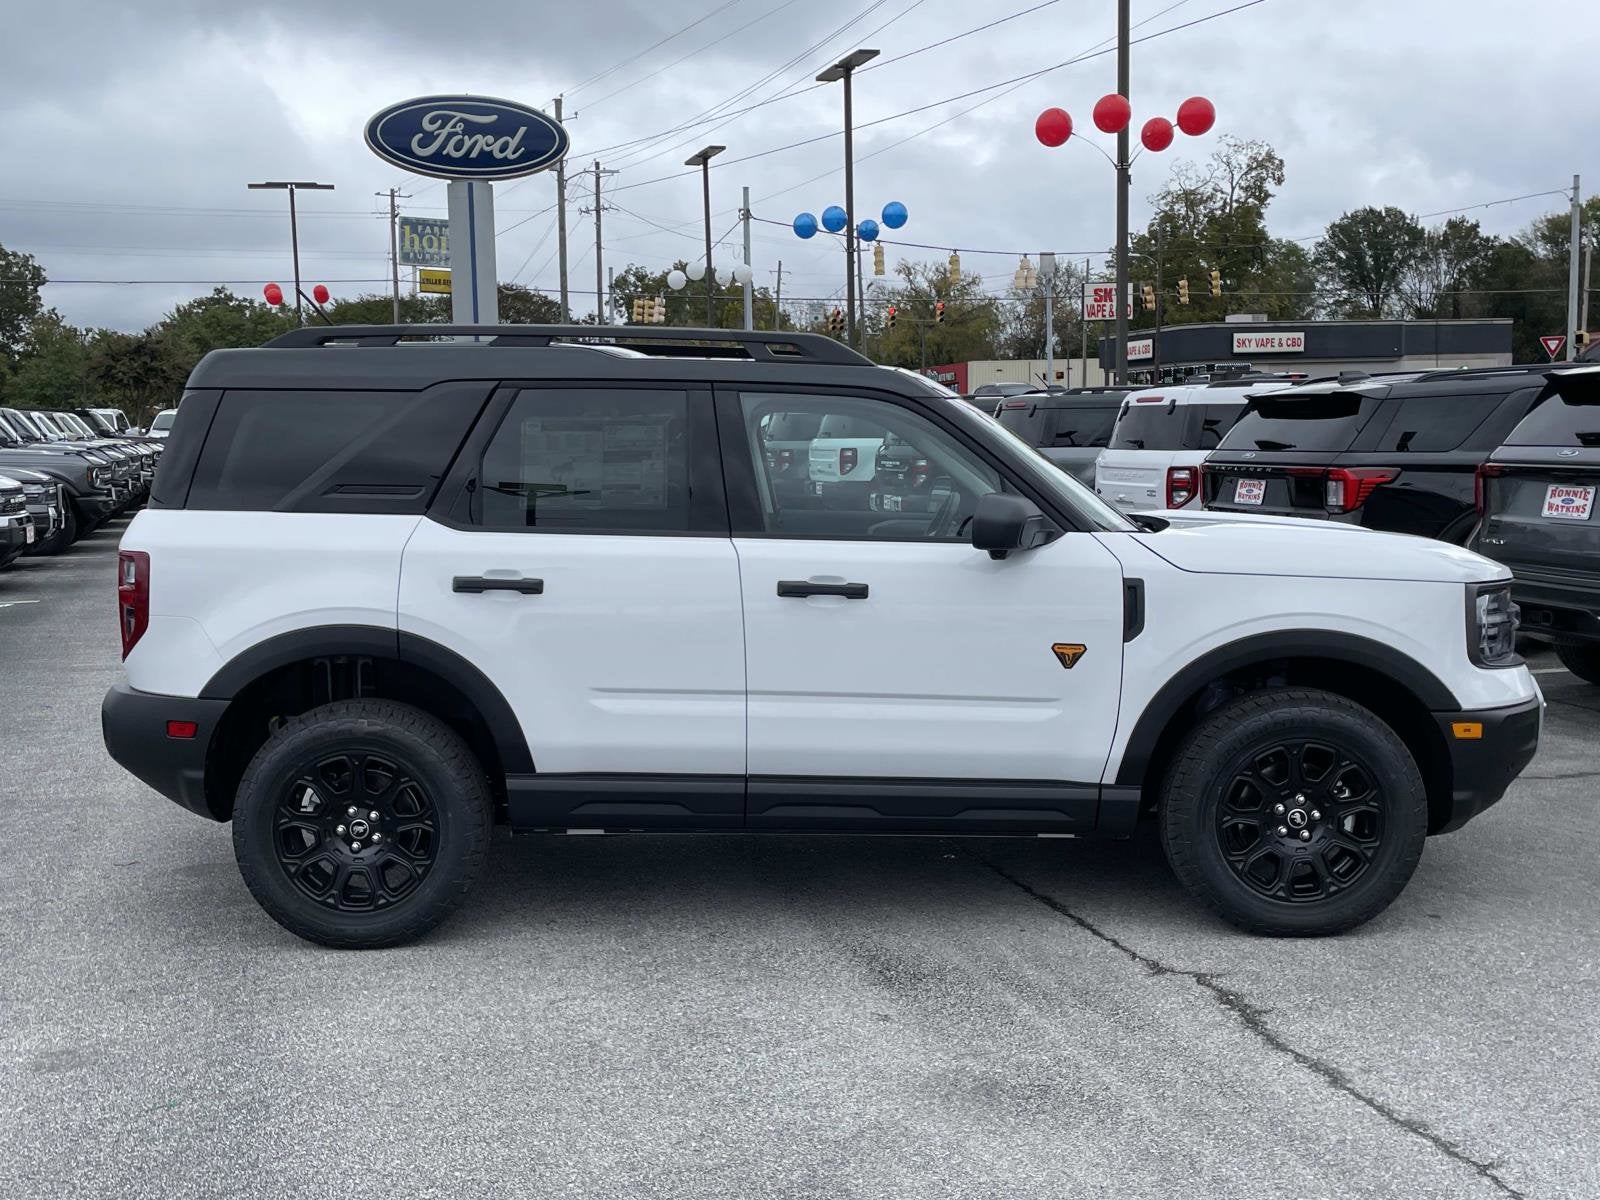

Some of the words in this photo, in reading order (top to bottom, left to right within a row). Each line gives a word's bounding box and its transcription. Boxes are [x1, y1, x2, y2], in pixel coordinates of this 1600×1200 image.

[411, 110, 527, 159] Ford
[1086, 304, 1106, 318] VAPE
[1109, 304, 1115, 317] &
[1236, 338, 1252, 348] SKY
[1255, 338, 1275, 348] VAPE
[1278, 338, 1283, 347] &
[1286, 337, 1302, 347] CBD
[1127, 346, 1137, 356] APE
[1240, 481, 1263, 491] RONNIE
[1238, 492, 1261, 501] WATKINS
[1550, 487, 1590, 501] RONNIE
[1547, 501, 1587, 514] WATKINS
